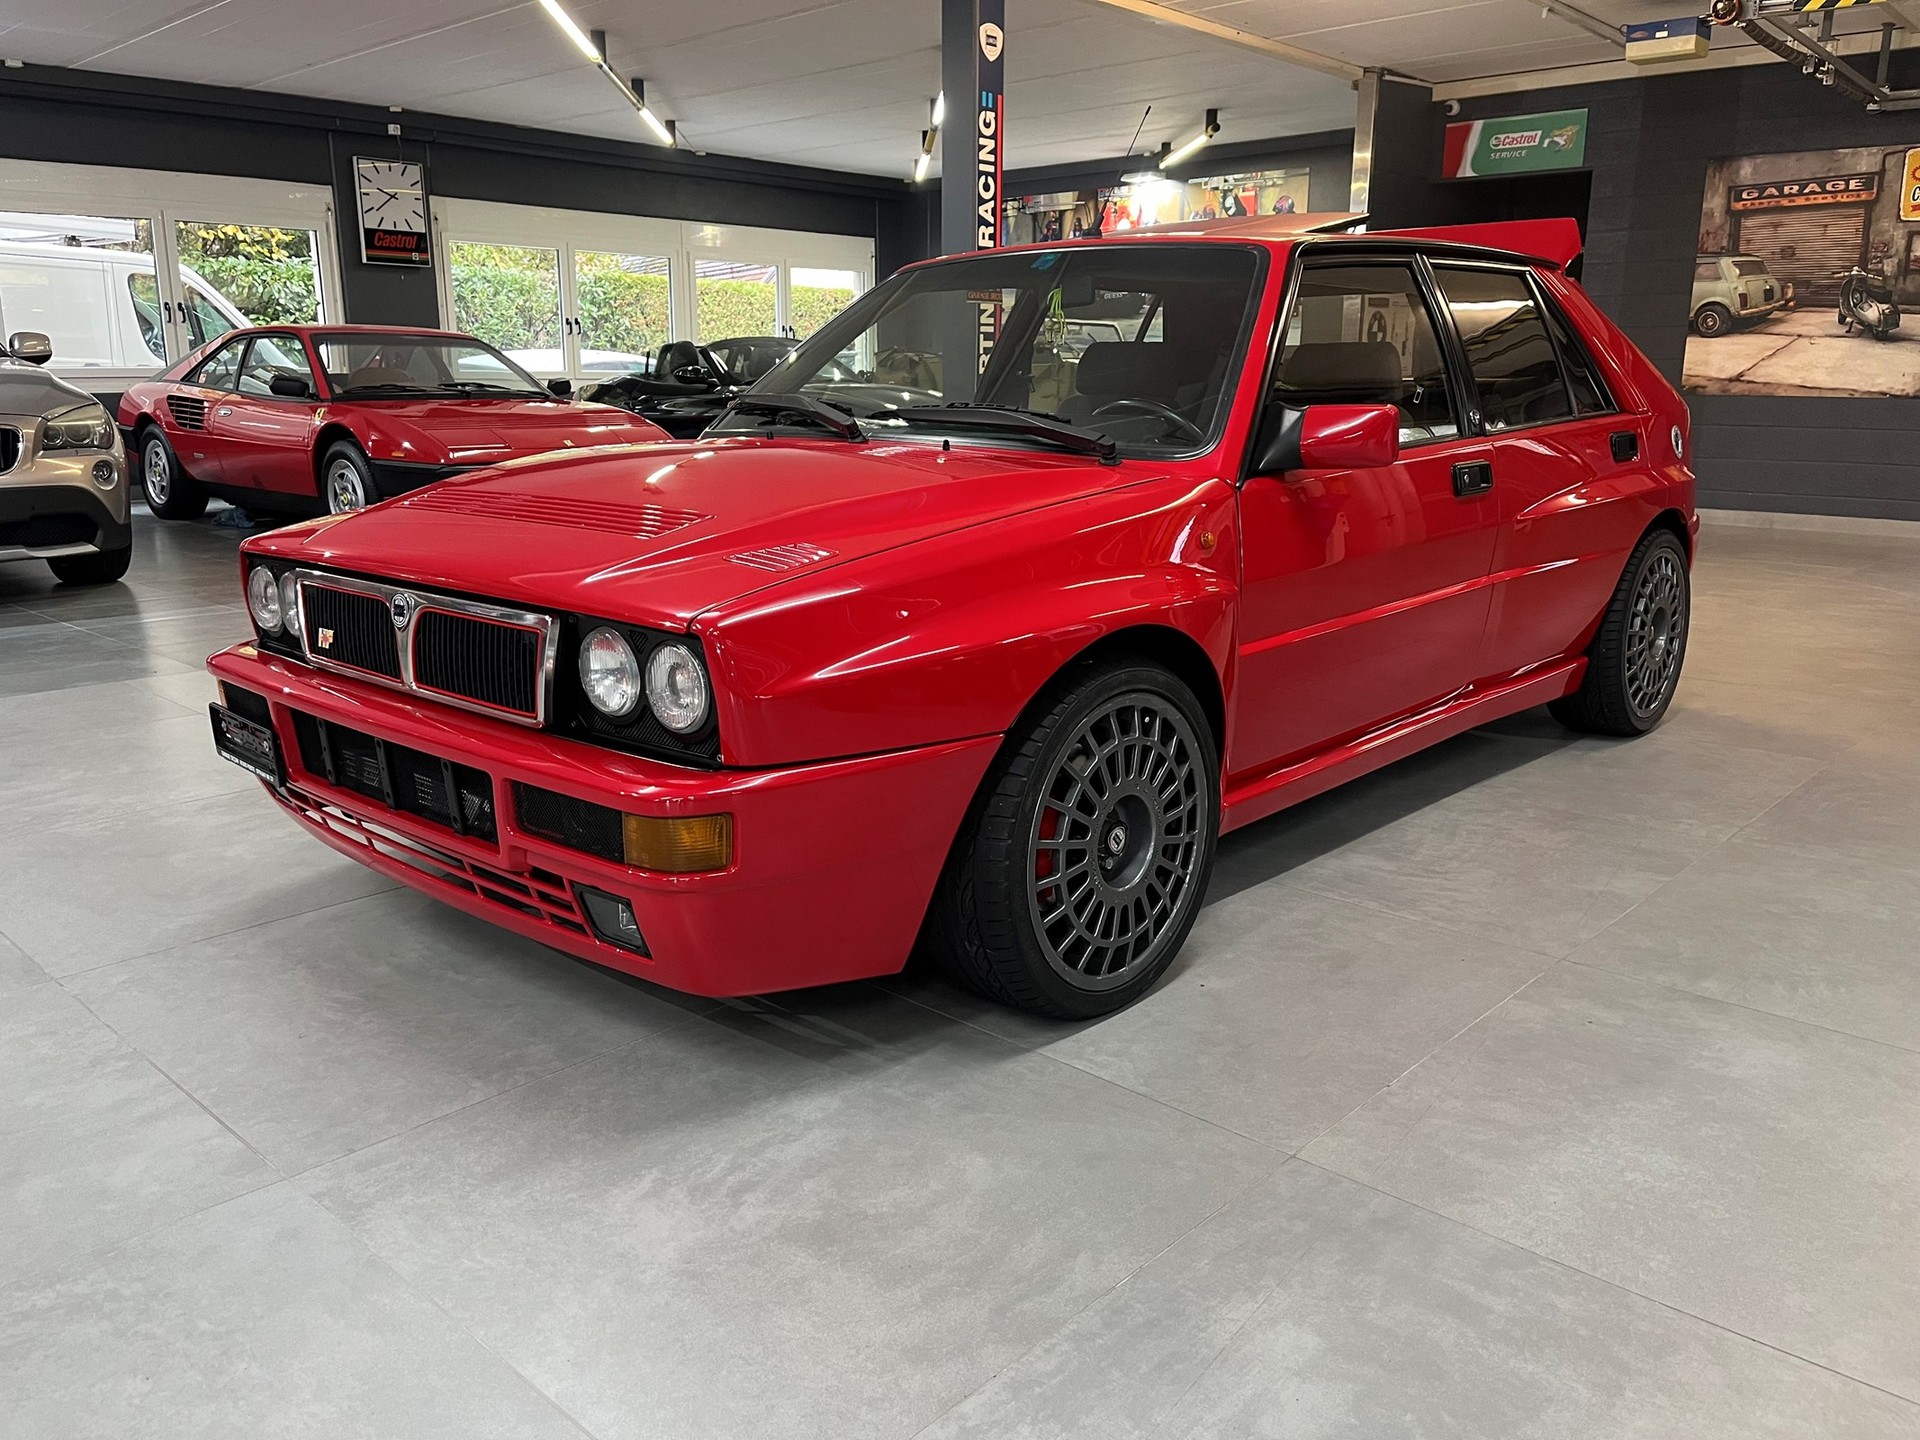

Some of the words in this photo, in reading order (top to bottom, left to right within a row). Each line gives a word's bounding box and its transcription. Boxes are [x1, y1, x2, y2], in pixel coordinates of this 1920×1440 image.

[1502, 133, 1538, 147] Castrol
[1490, 150, 1527, 160] SERVICE
[978, 110, 996, 248] RACING
[1741, 178, 1866, 200] GARAGE
[374, 231, 418, 249] Castrol
